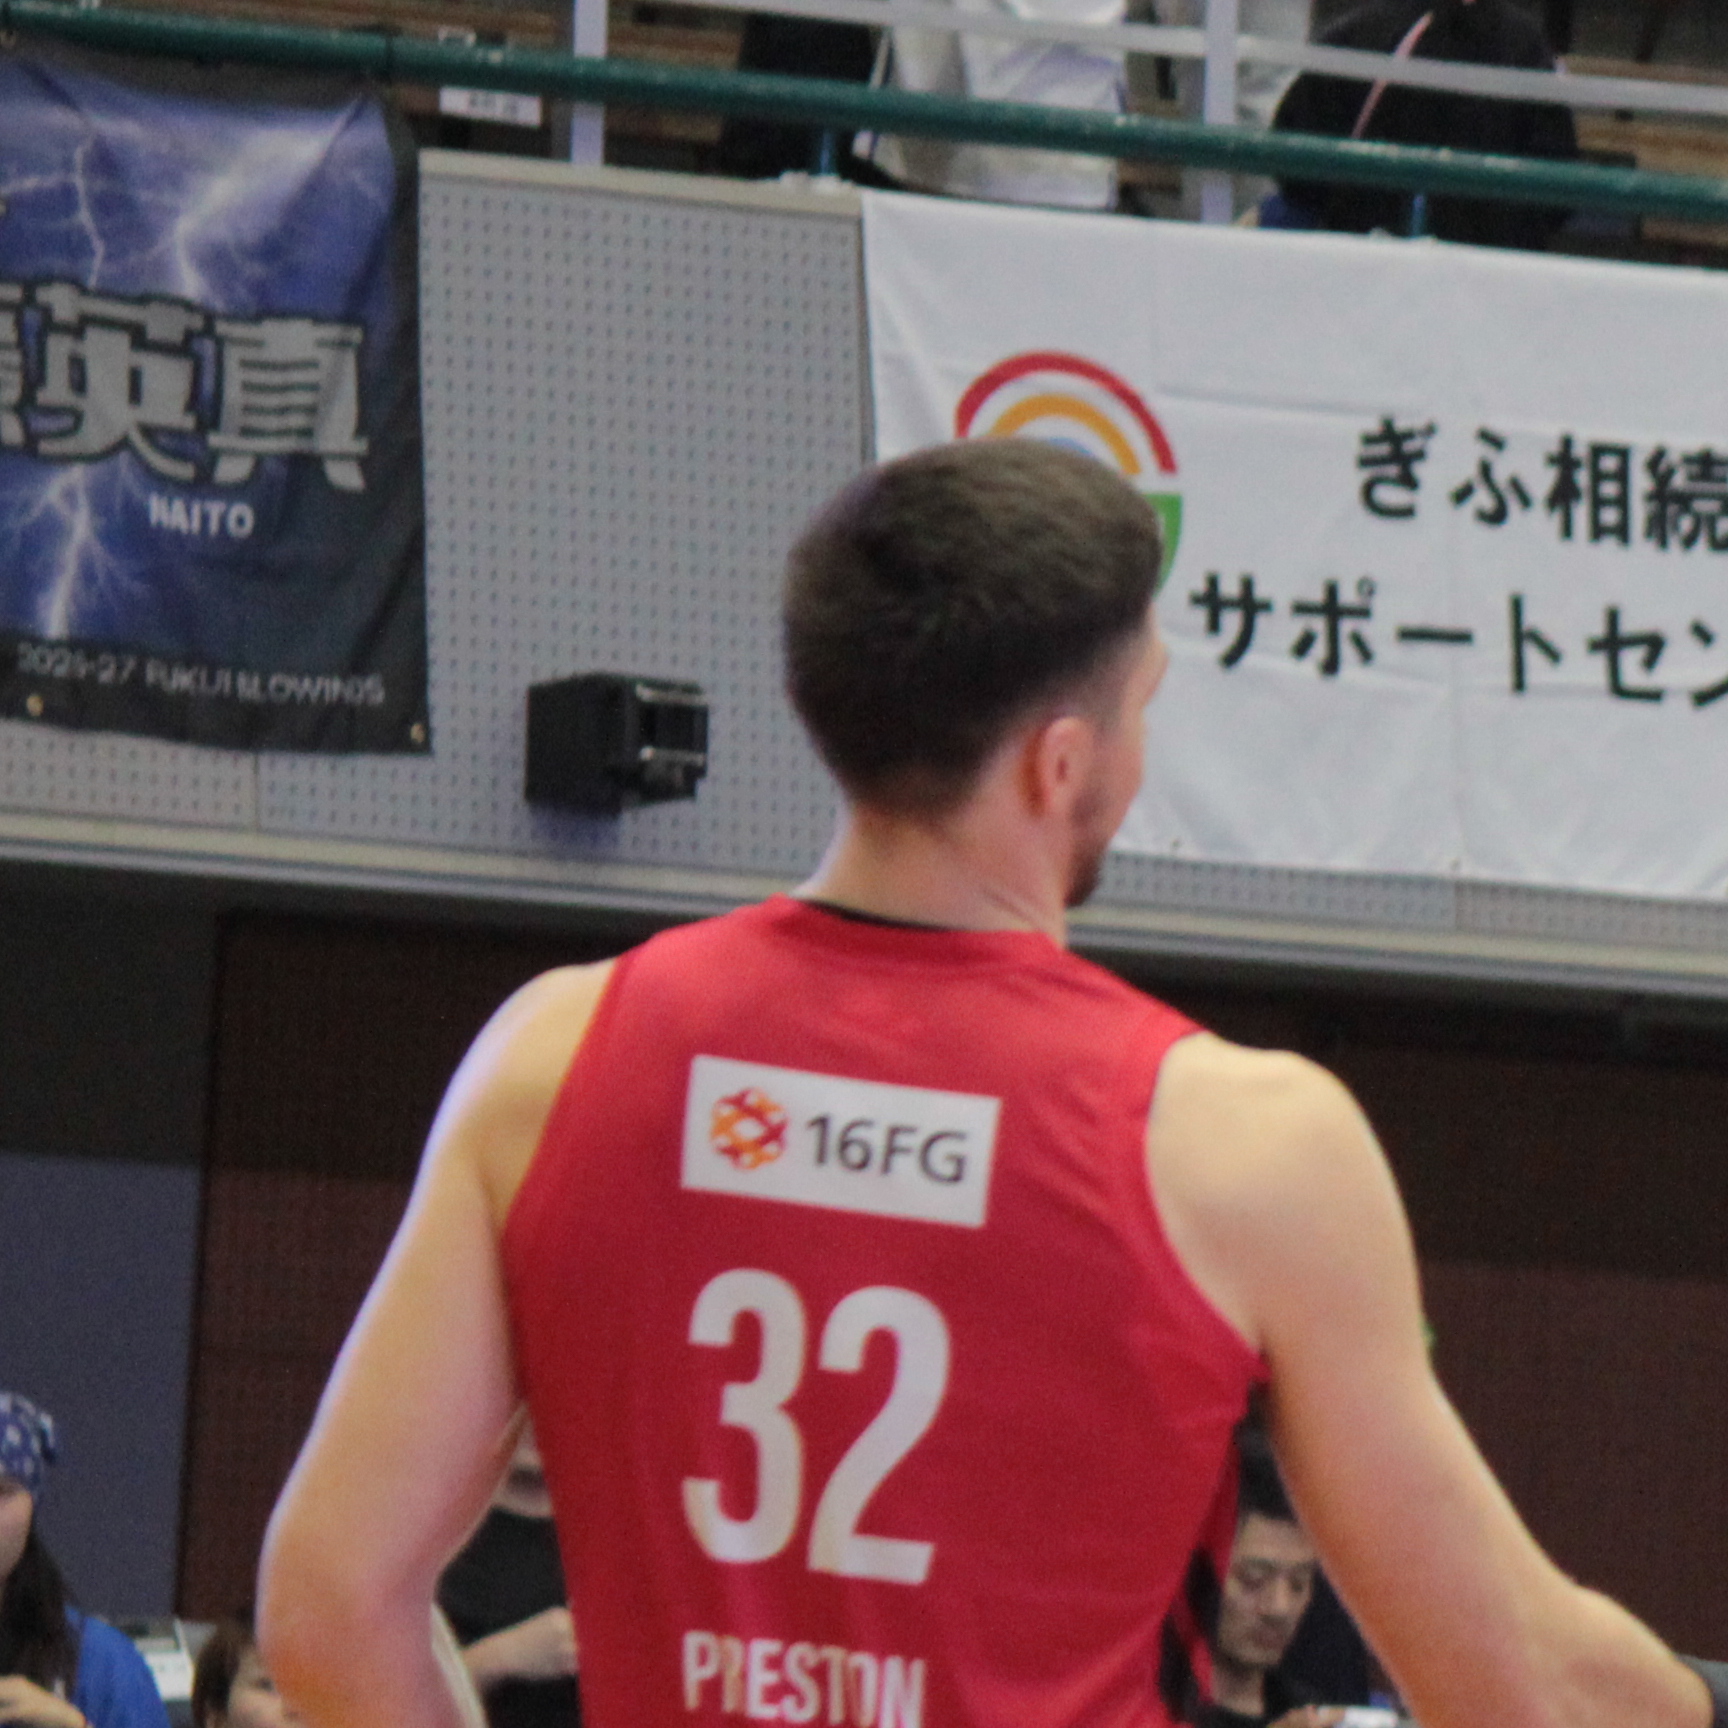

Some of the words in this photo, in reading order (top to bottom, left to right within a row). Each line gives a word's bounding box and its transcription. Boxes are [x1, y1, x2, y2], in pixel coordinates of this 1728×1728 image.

[0, 283, 370, 493] 英真
[805, 1112, 969, 1187] 16FG
[682, 1267, 952, 1586] 32
